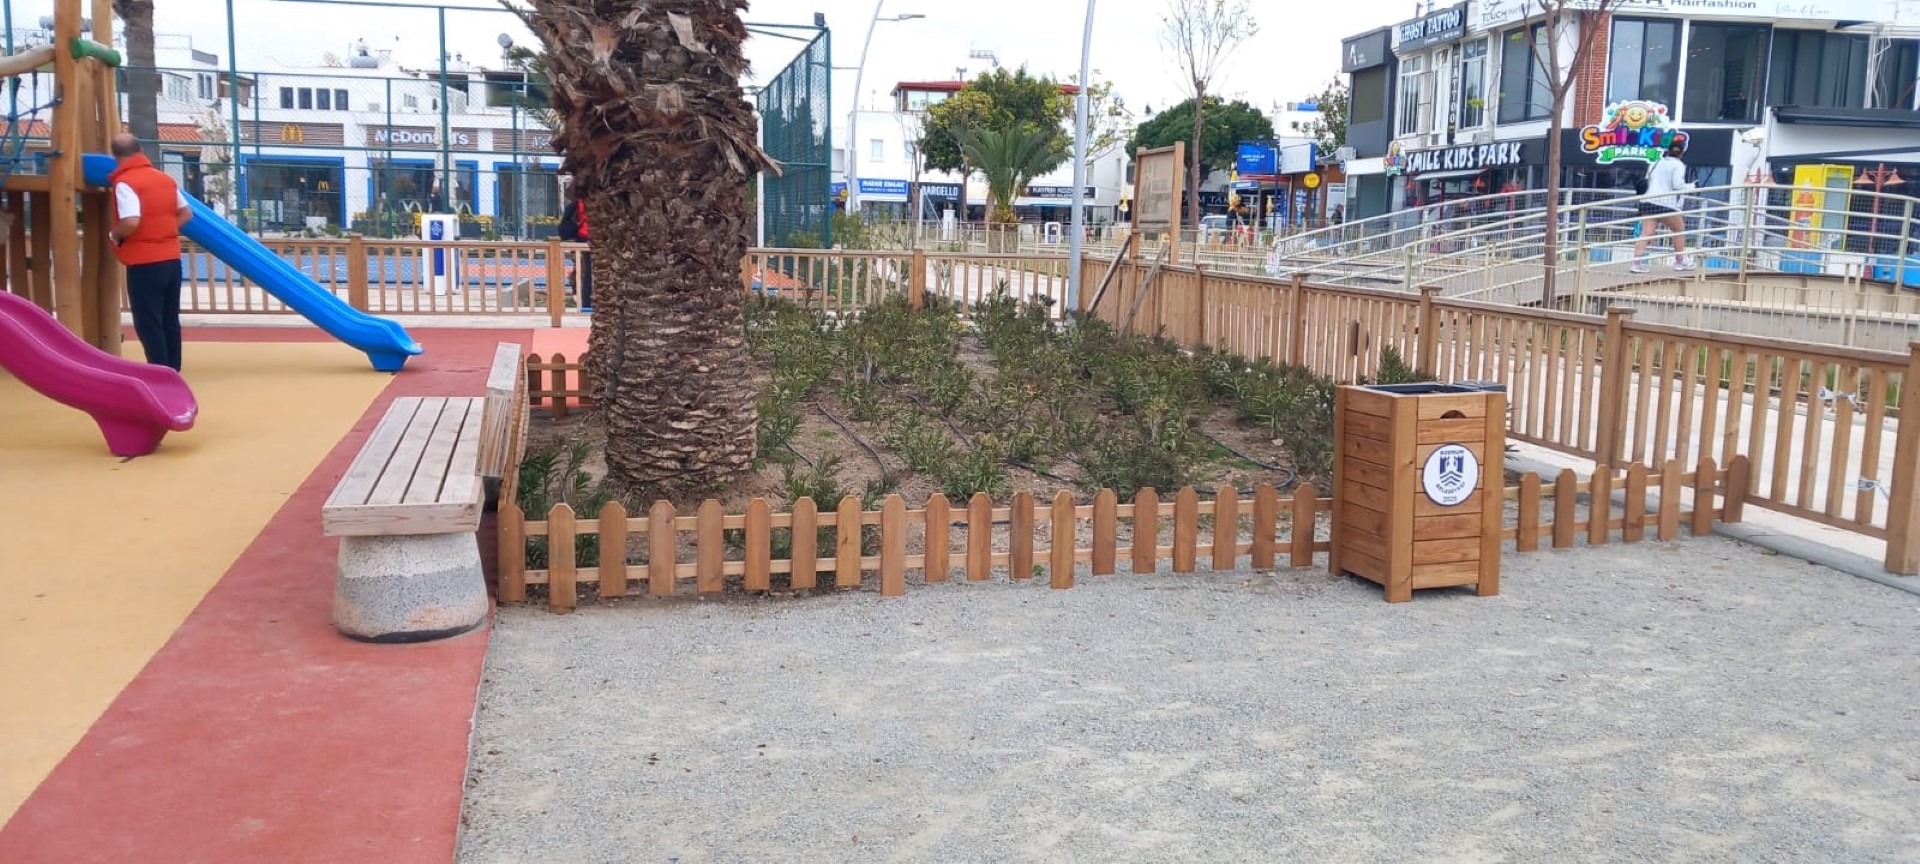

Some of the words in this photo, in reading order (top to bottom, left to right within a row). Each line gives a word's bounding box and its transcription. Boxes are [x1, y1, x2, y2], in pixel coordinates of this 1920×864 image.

[1400, 20, 1425, 42] GHOST
[1427, 10, 1460, 34] TATTOO
[1406, 150, 1441, 172] SMILE
[1444, 146, 1475, 169] KIDS
[1478, 142, 1521, 166] PARK
[1614, 147, 1647, 157] PARK
